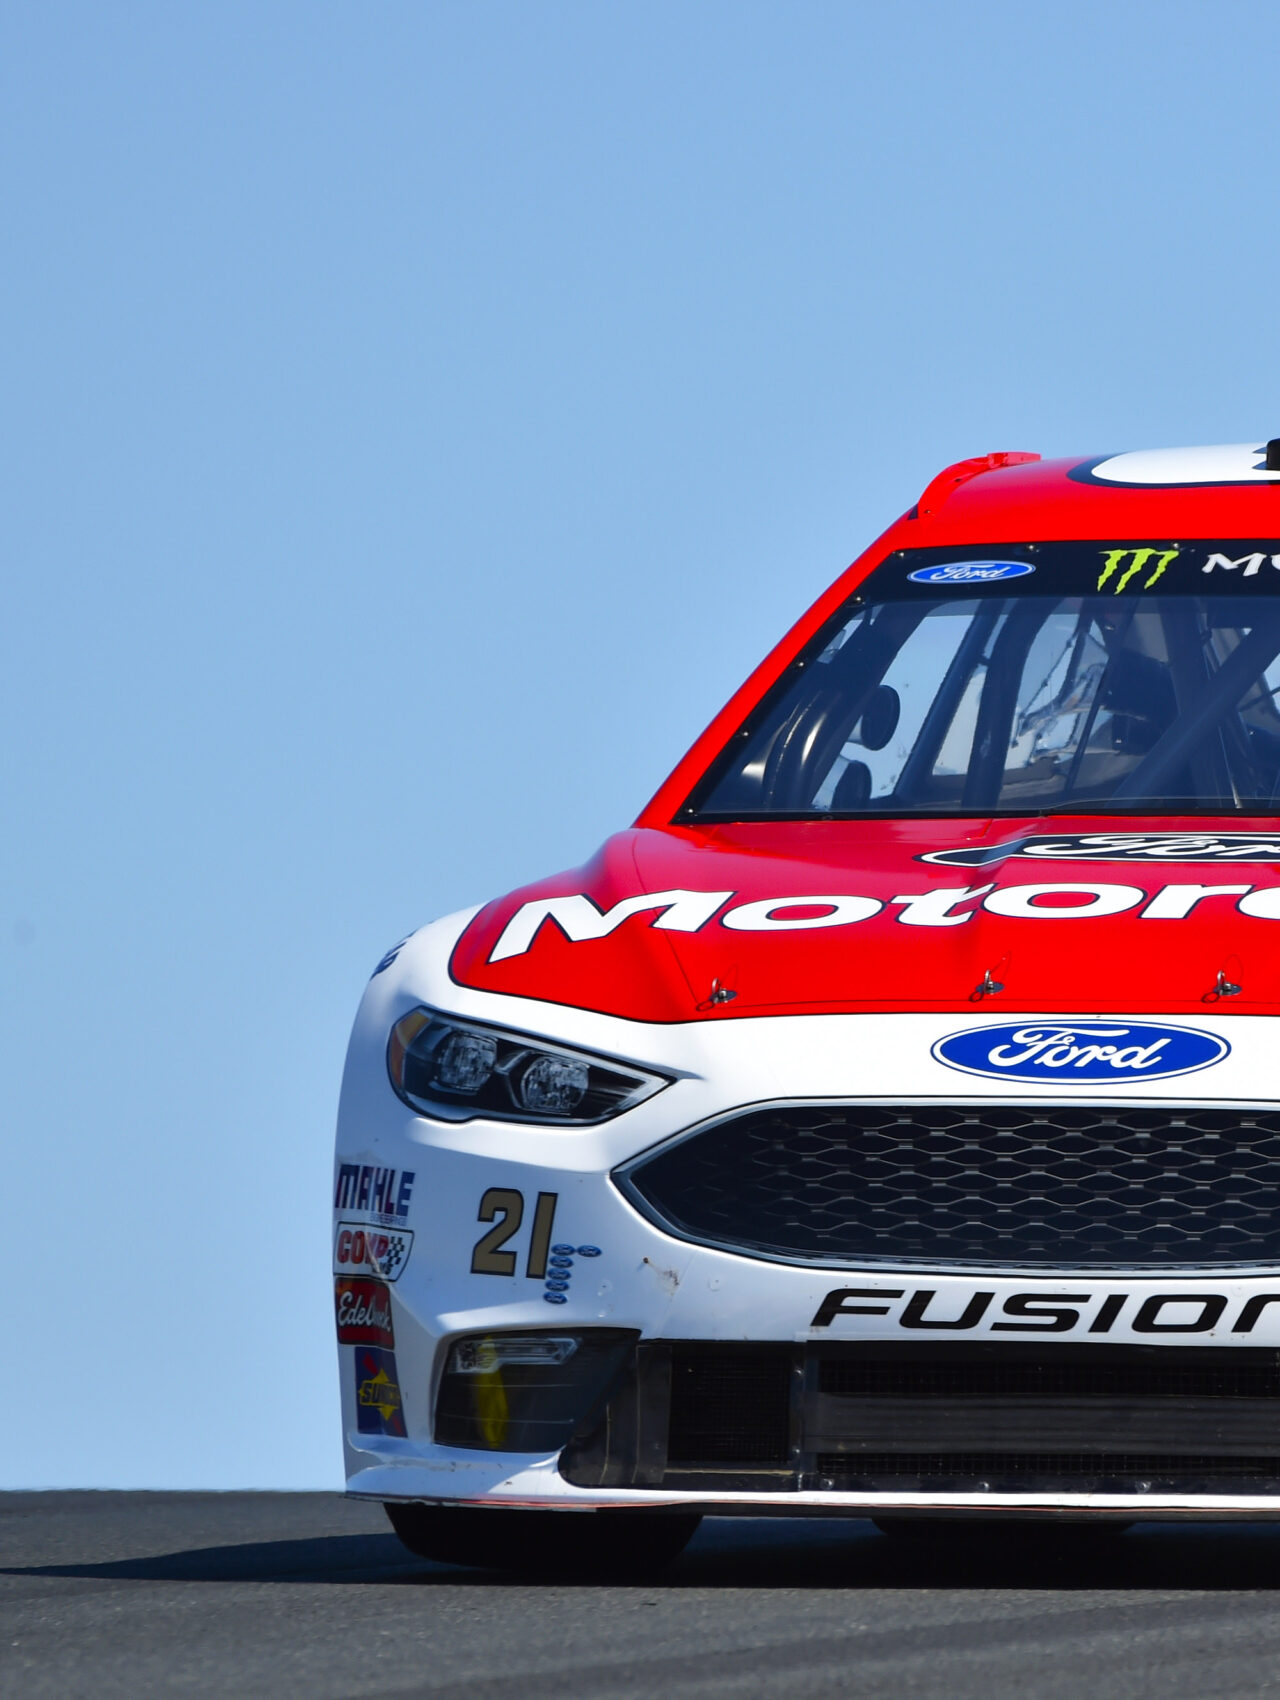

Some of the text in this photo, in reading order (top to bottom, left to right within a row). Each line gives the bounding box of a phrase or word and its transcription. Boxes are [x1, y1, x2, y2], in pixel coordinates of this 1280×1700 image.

[930, 561, 1011, 581] Ford
[987, 1025, 1172, 1070] Ford
[335, 1164, 416, 1217] MAHLE
[470, 1187, 559, 1279] 21
